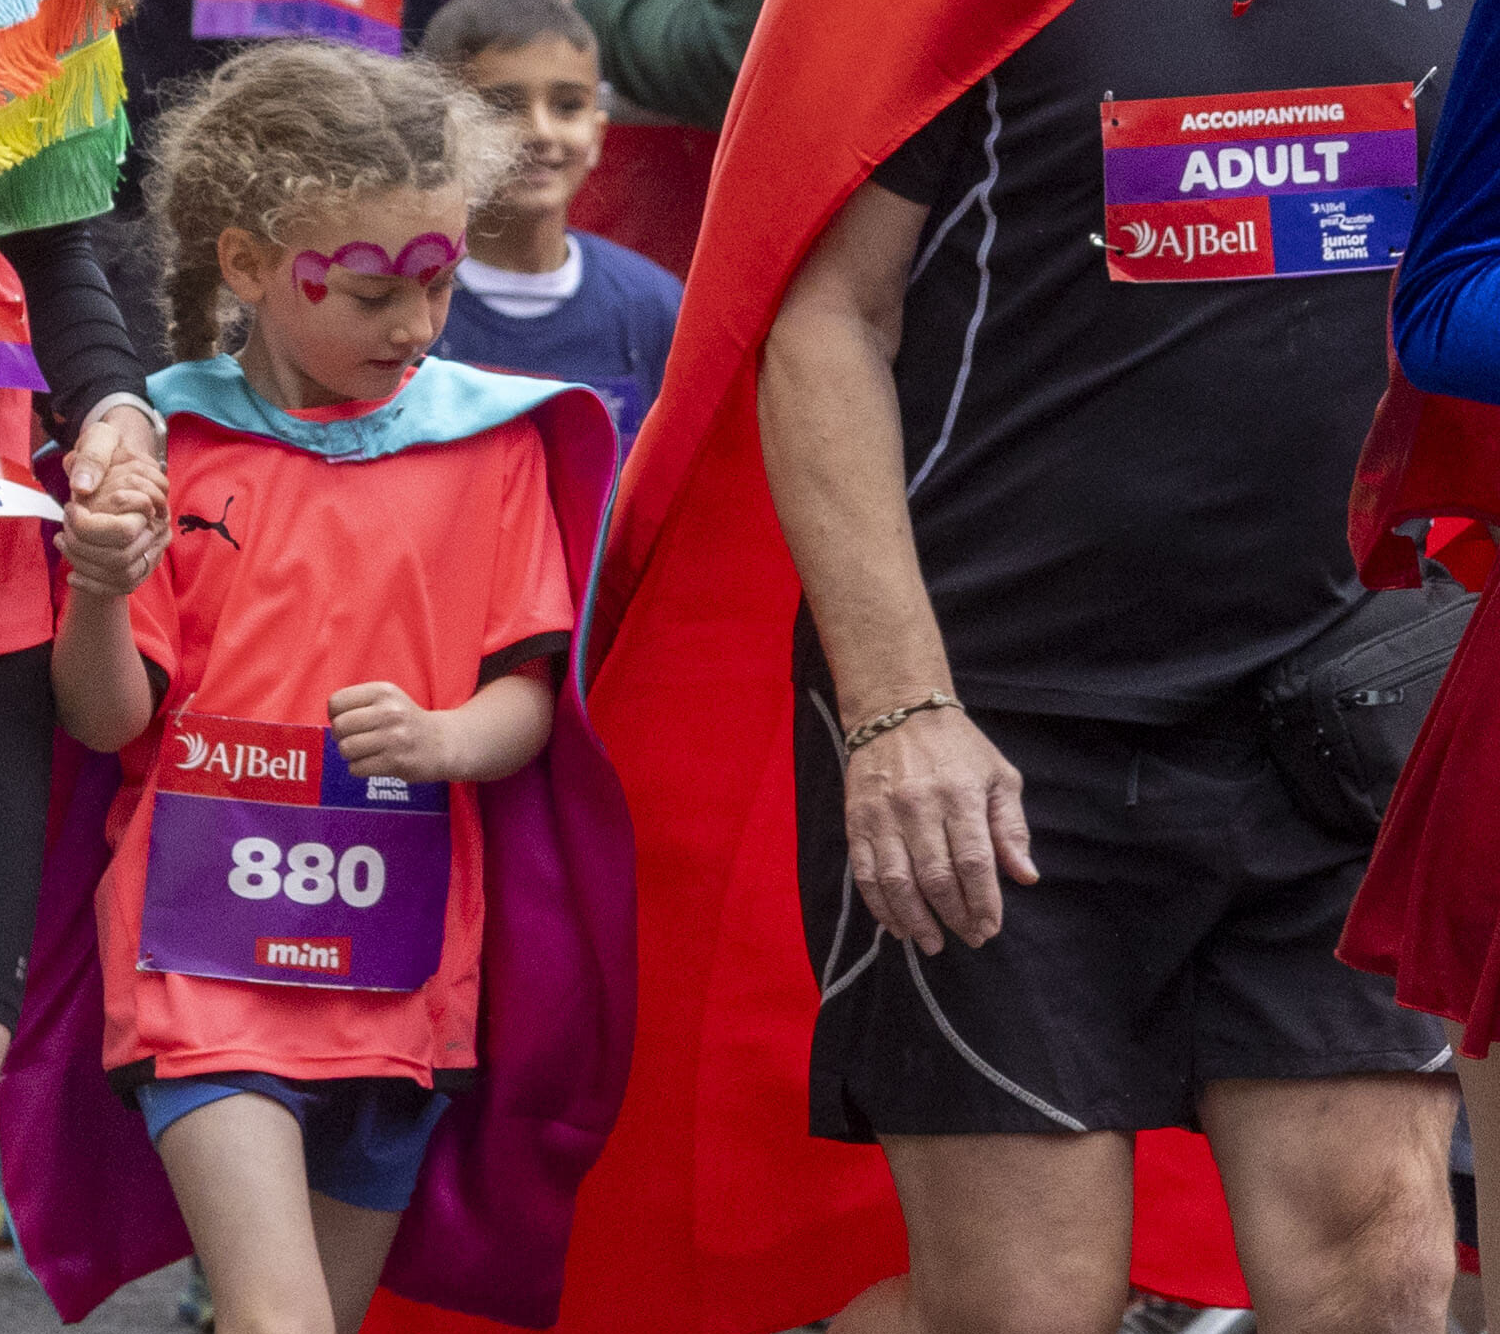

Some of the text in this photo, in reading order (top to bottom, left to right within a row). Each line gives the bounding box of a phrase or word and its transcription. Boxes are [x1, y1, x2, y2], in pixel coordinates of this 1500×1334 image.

[1181, 103, 1345, 132] ACCOMPANYING
[1179, 141, 1350, 193] ADULT
[1322, 232, 1368, 248] junior
[228, 837, 385, 907] 880
[267, 943, 339, 968] mini
